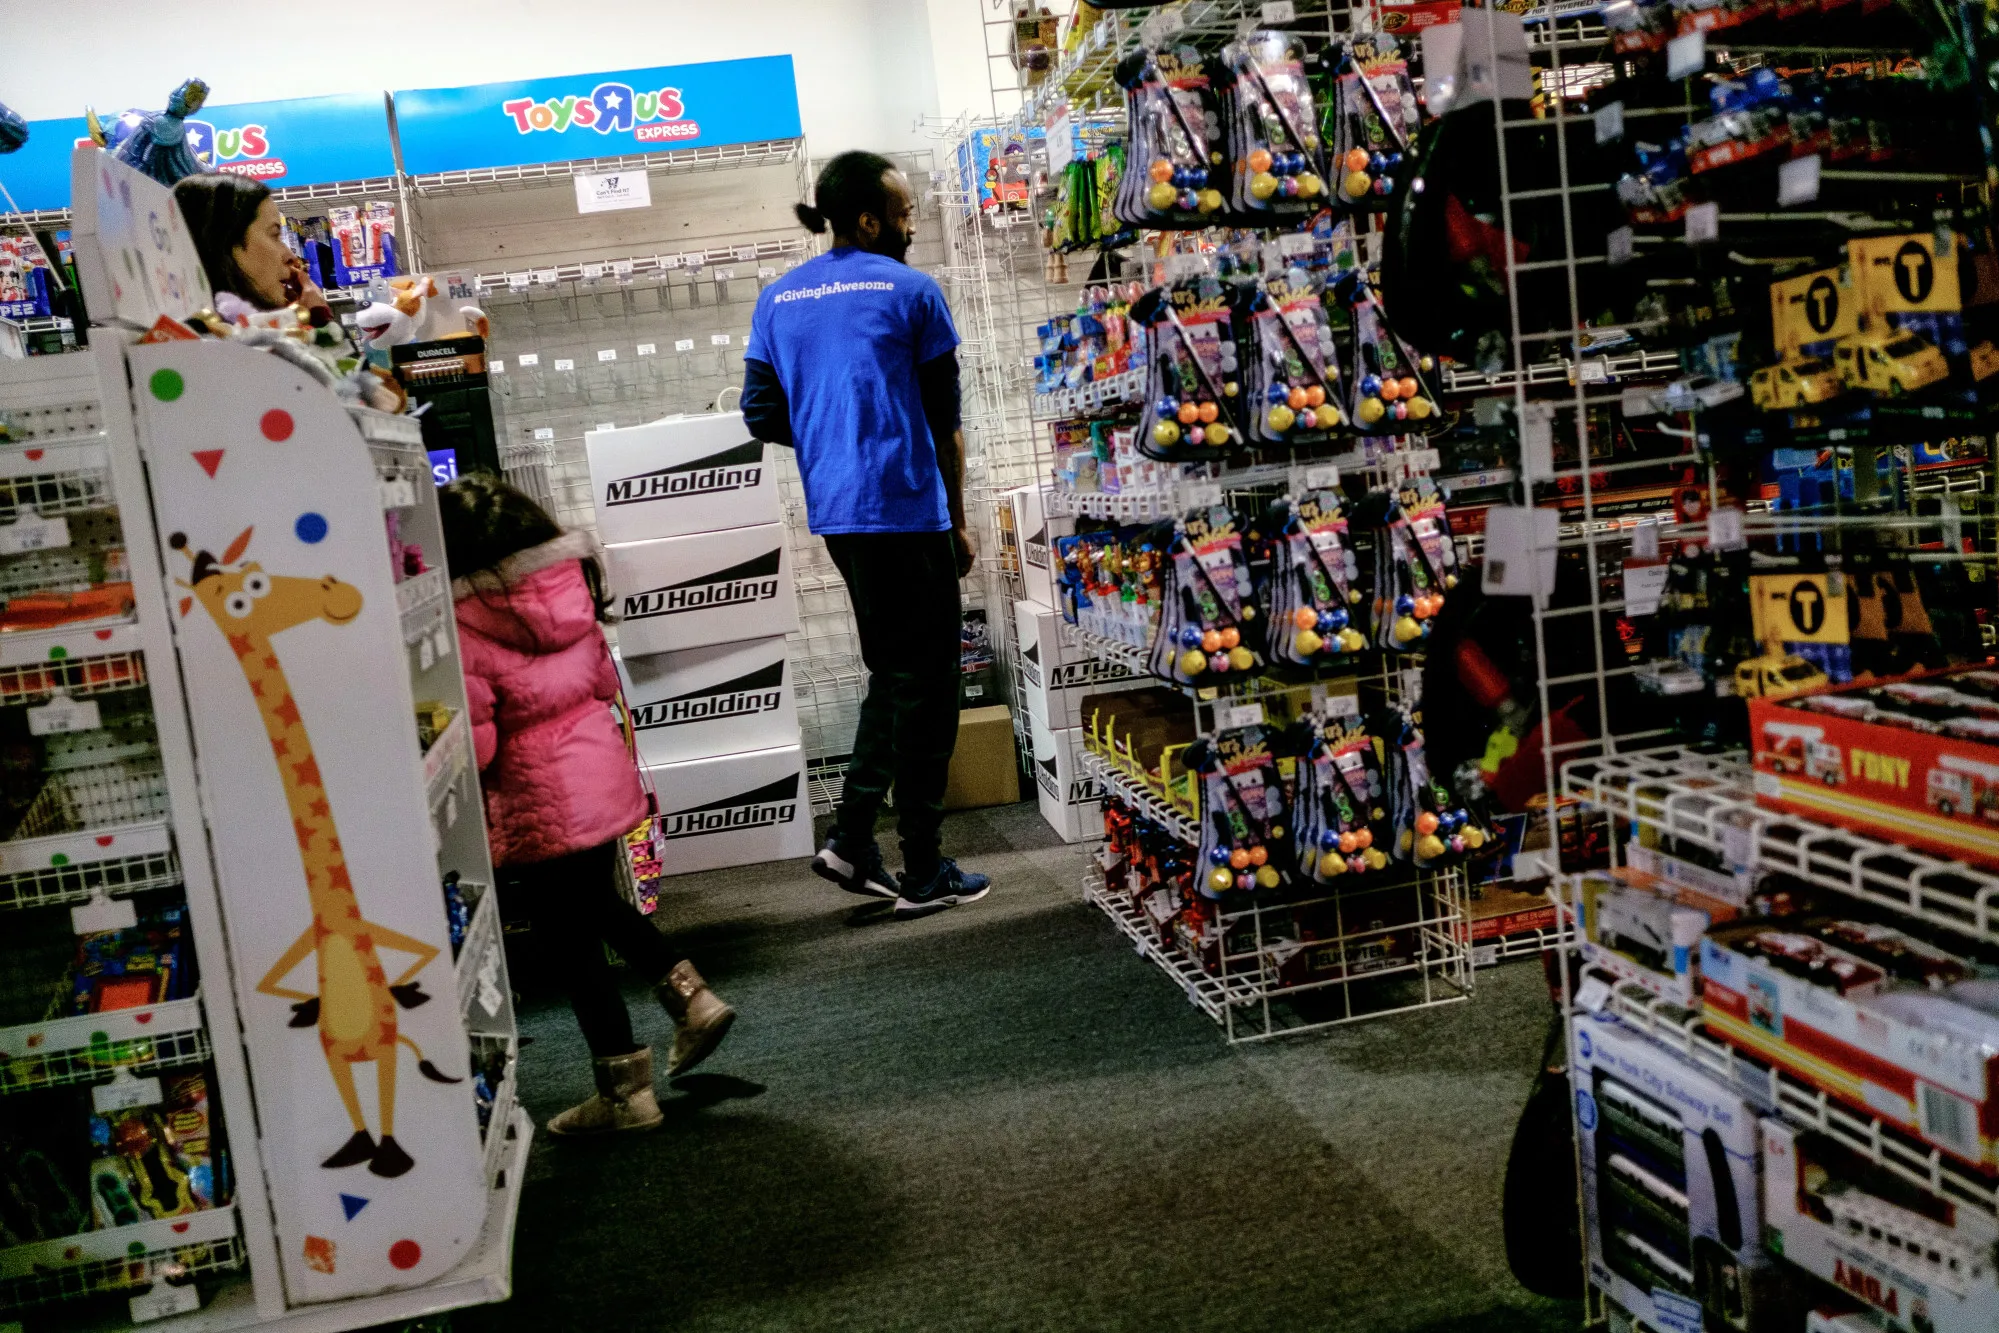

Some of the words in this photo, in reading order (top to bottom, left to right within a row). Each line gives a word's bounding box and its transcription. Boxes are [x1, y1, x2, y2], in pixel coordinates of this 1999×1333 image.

[1532, 7, 1546, 15] AIR
[1551, 0, 1594, 12] OWERED
[348, 268, 383, 282] PEZ
[1901, 253, 1925, 298] T
[774, 281, 894, 304] #GivingIsAwesome
[0, 303, 35, 317] PEZ
[1812, 287, 1831, 328] T
[417, 347, 458, 358] DURACELL
[1795, 590, 1818, 630] T
